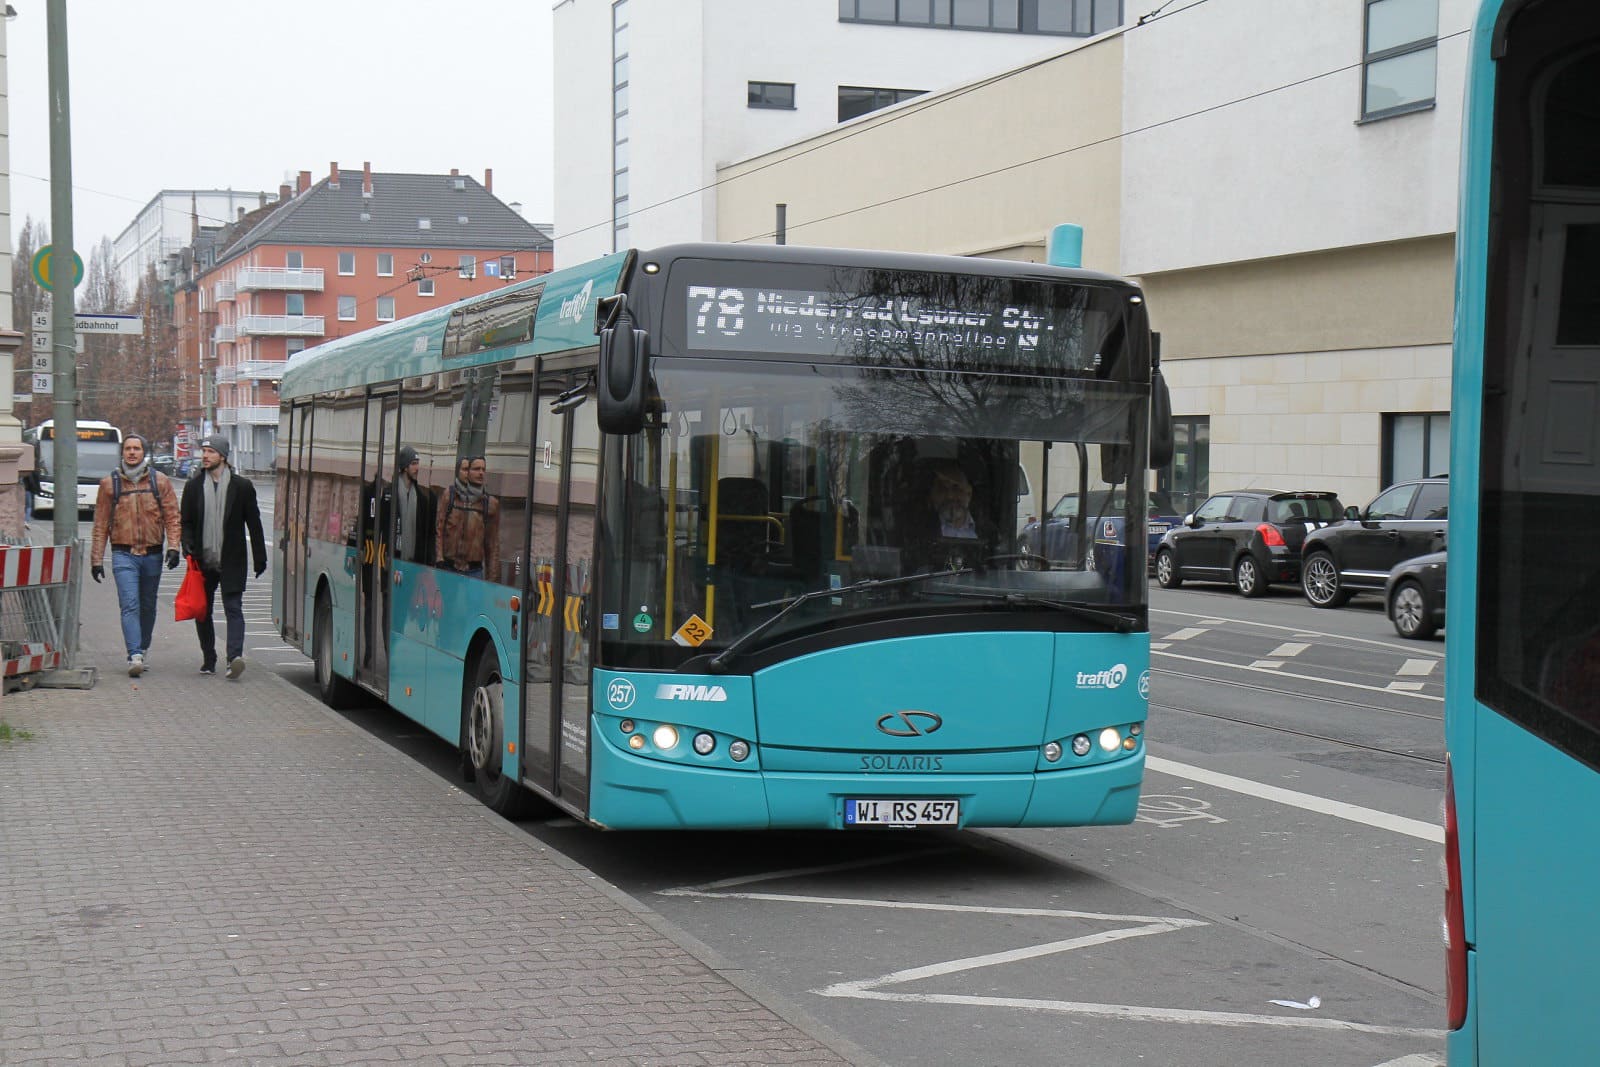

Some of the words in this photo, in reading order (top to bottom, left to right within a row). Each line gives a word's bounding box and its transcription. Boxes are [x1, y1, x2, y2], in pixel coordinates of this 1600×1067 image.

[688, 286, 744, 336] 78
[35, 316, 47, 326] 45
[35, 337, 47, 346] 47
[35, 358, 47, 367] 48
[36, 378, 48, 388] 78
[685, 622, 706, 642] 22
[610, 684, 632, 703] 257
[860, 755, 943, 771] SOLARIS
[857, 802, 880, 822] WI
[892, 802, 917, 822] RS
[921, 802, 955, 822] 457
